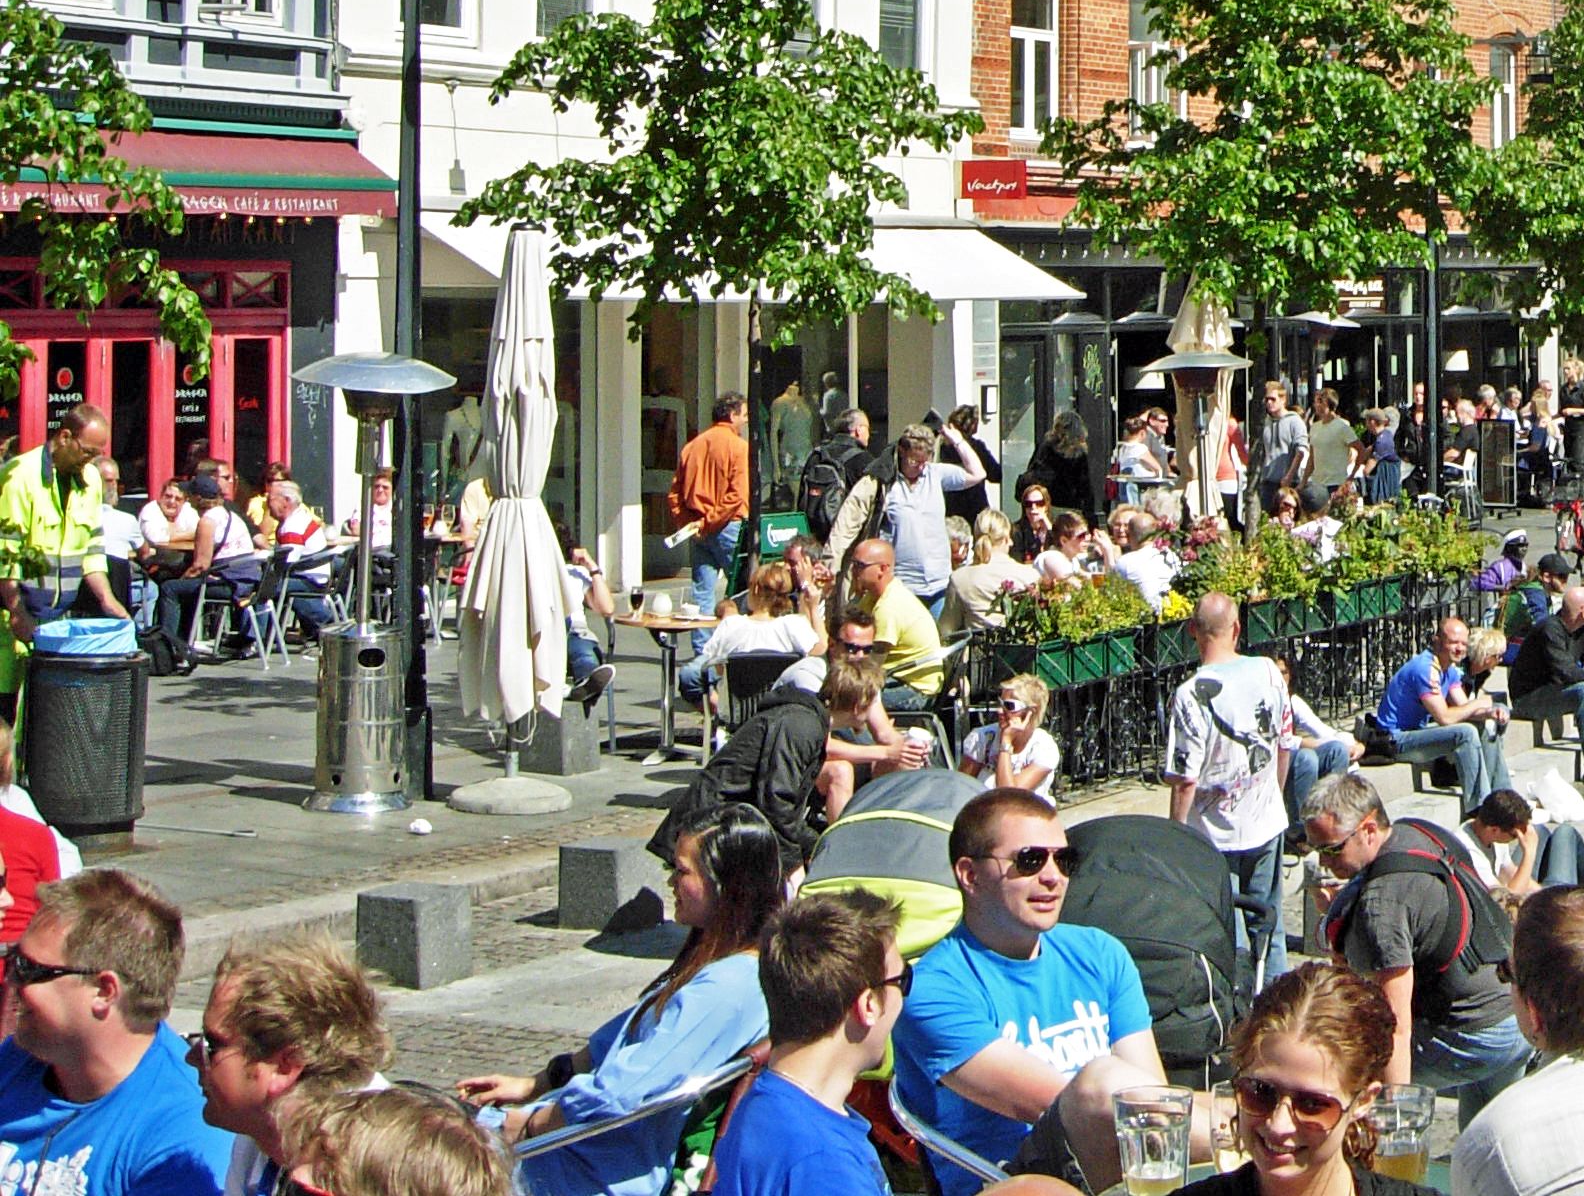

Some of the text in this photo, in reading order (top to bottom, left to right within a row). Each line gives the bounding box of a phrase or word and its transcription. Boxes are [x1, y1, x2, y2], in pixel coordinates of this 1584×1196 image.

[180, 191, 339, 212] RAGEN CAFÉ & RESTAURANT
